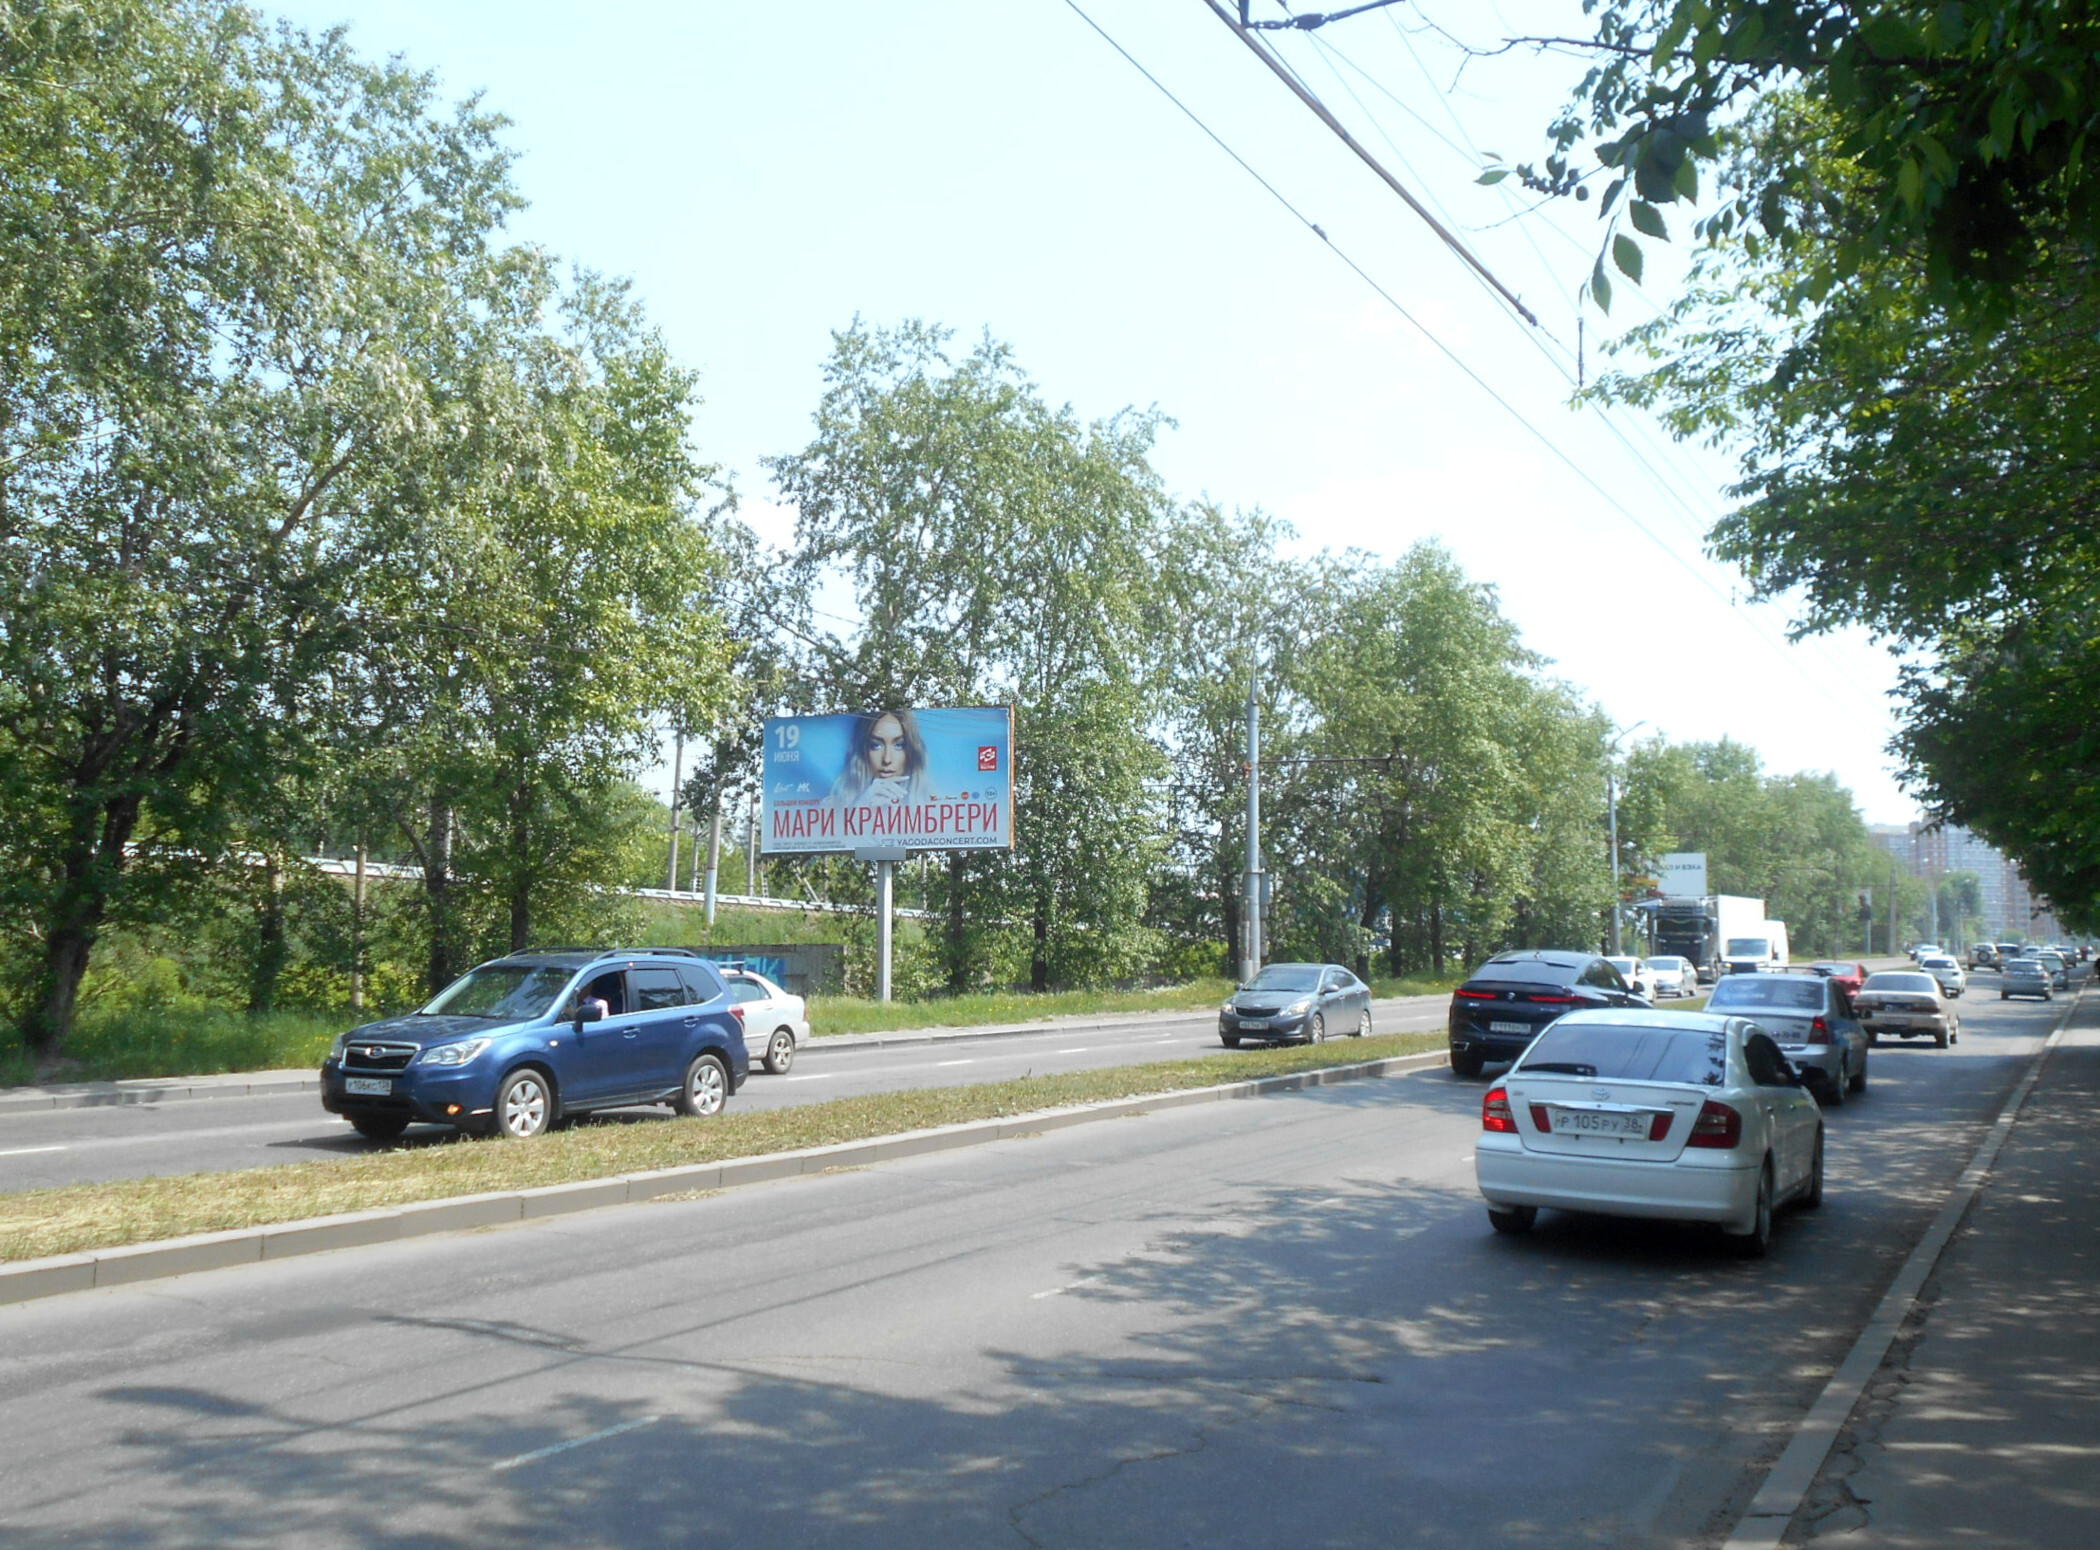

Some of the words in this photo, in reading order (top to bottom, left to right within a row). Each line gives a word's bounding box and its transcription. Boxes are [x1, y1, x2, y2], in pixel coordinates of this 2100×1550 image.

[774, 724, 800, 749] 19
[773, 750, 800, 763] ИЮНЯ
[773, 808, 835, 839] МАРИ
[843, 798, 998, 837] КРАЙМБРЕРИ
[896, 836, 998, 847] YAGODACONCERT.COM
